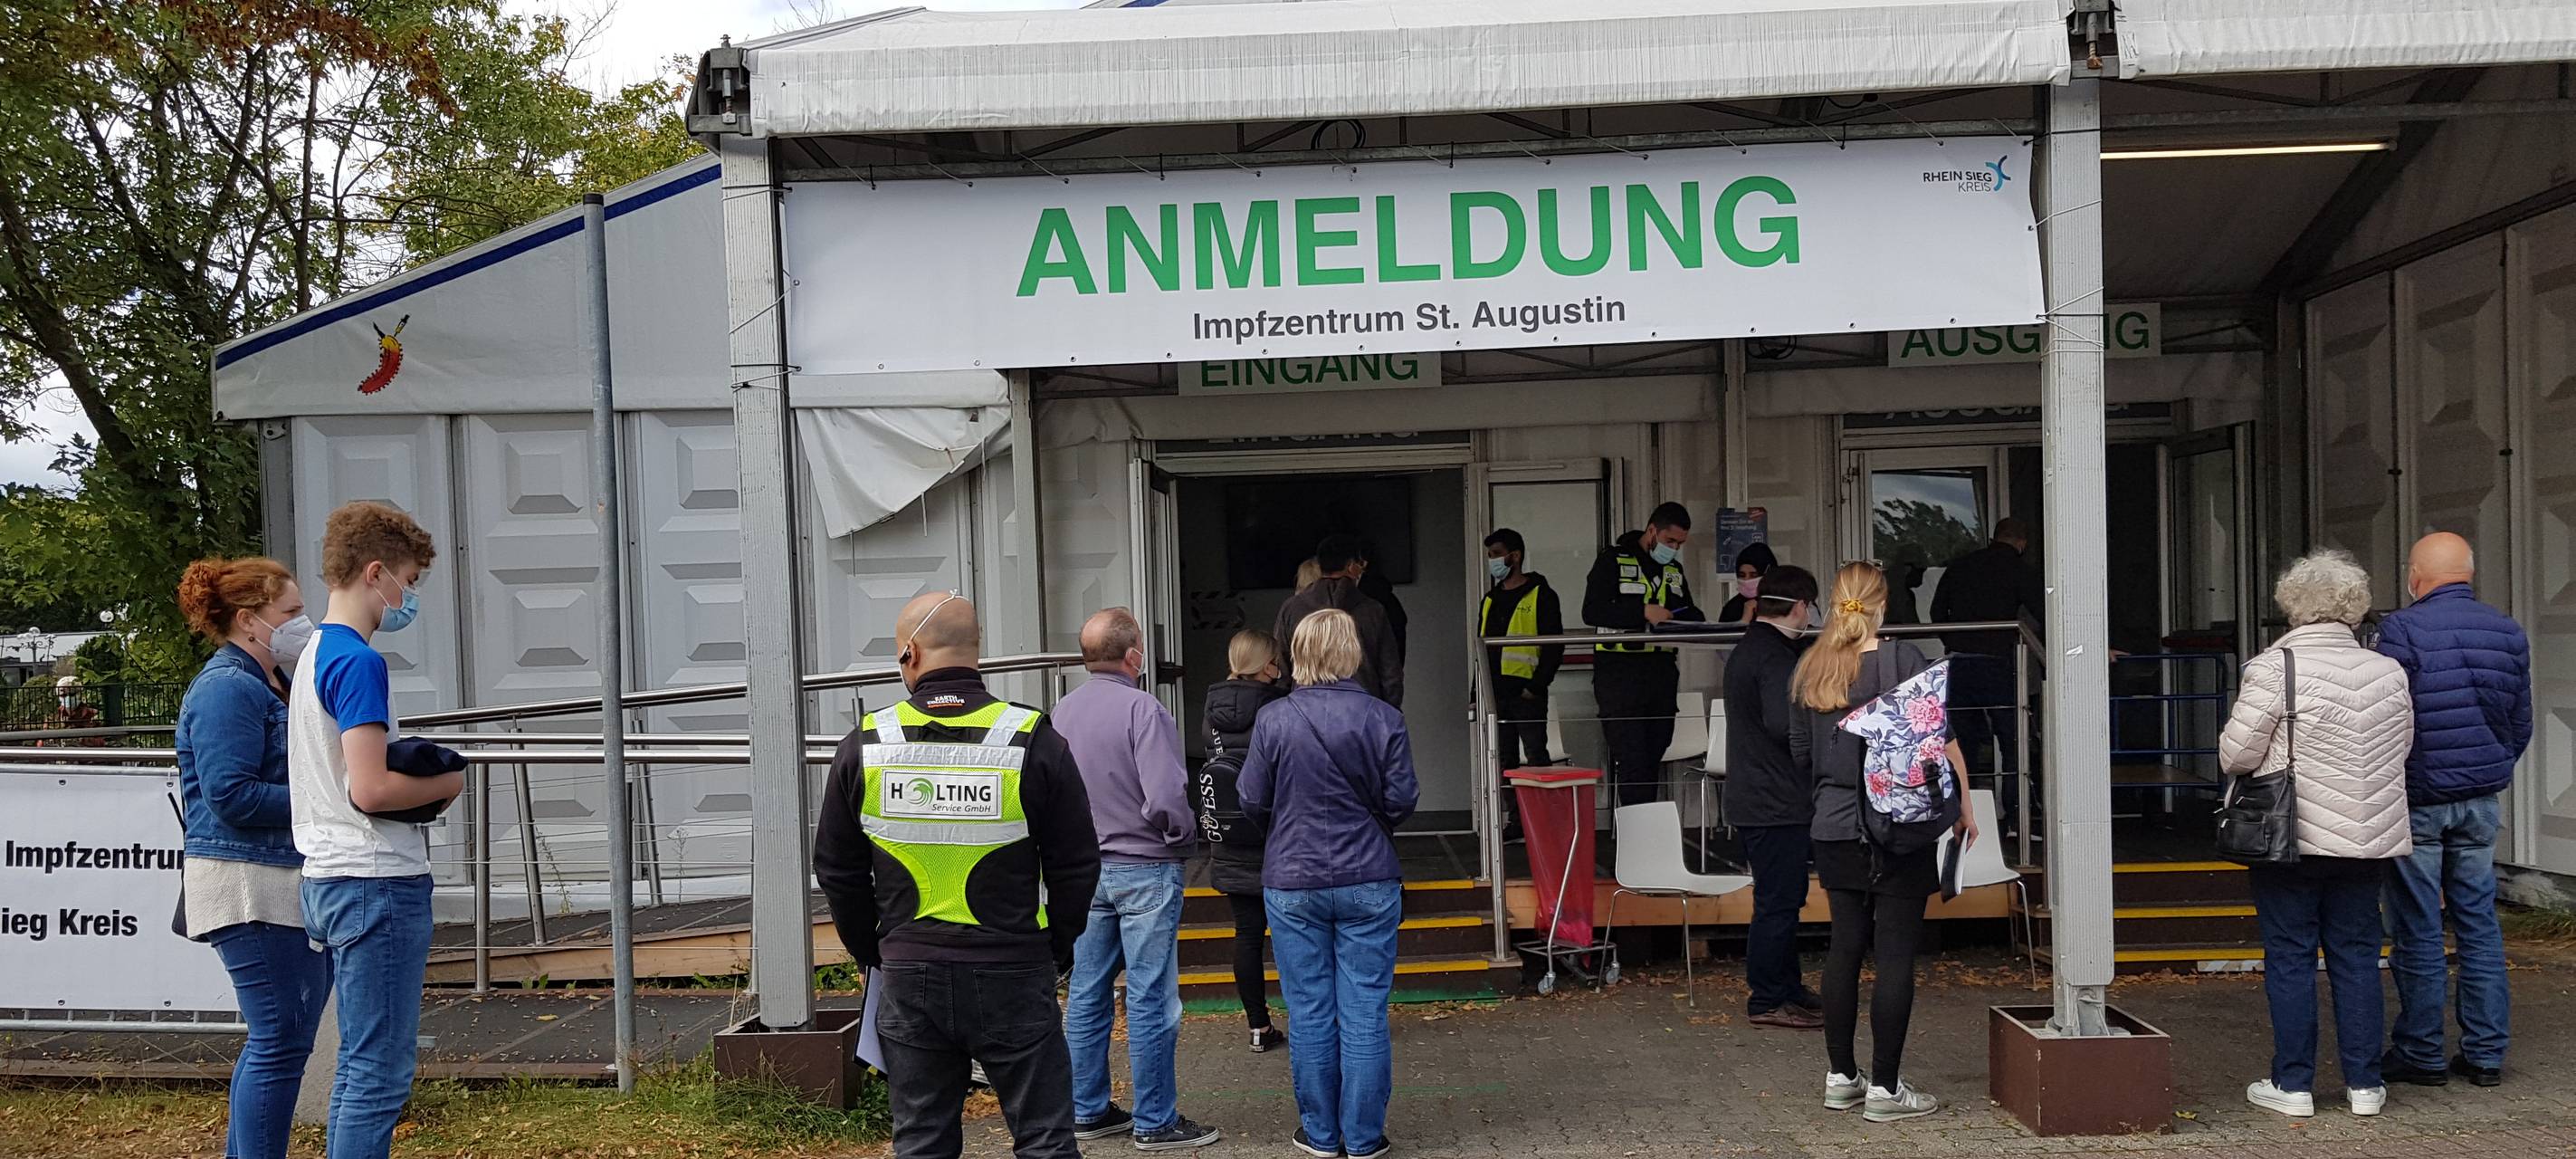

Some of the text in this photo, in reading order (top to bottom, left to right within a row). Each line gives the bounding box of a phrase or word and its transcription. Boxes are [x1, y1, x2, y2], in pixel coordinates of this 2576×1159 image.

[1923, 171, 1992, 182] RHEIN SIEG
[1958, 182, 1991, 192] KREIS
[1016, 176, 1799, 296] ANMELDUNG
[1194, 296, 1626, 345] Impfzentrum St. Augustin
[1901, 311, 2151, 358] AUSGG
[1201, 352, 1419, 388] EINGANG
[931, 804, 992, 813] Service GmbH
[59, 908, 138, 936] Kreis
